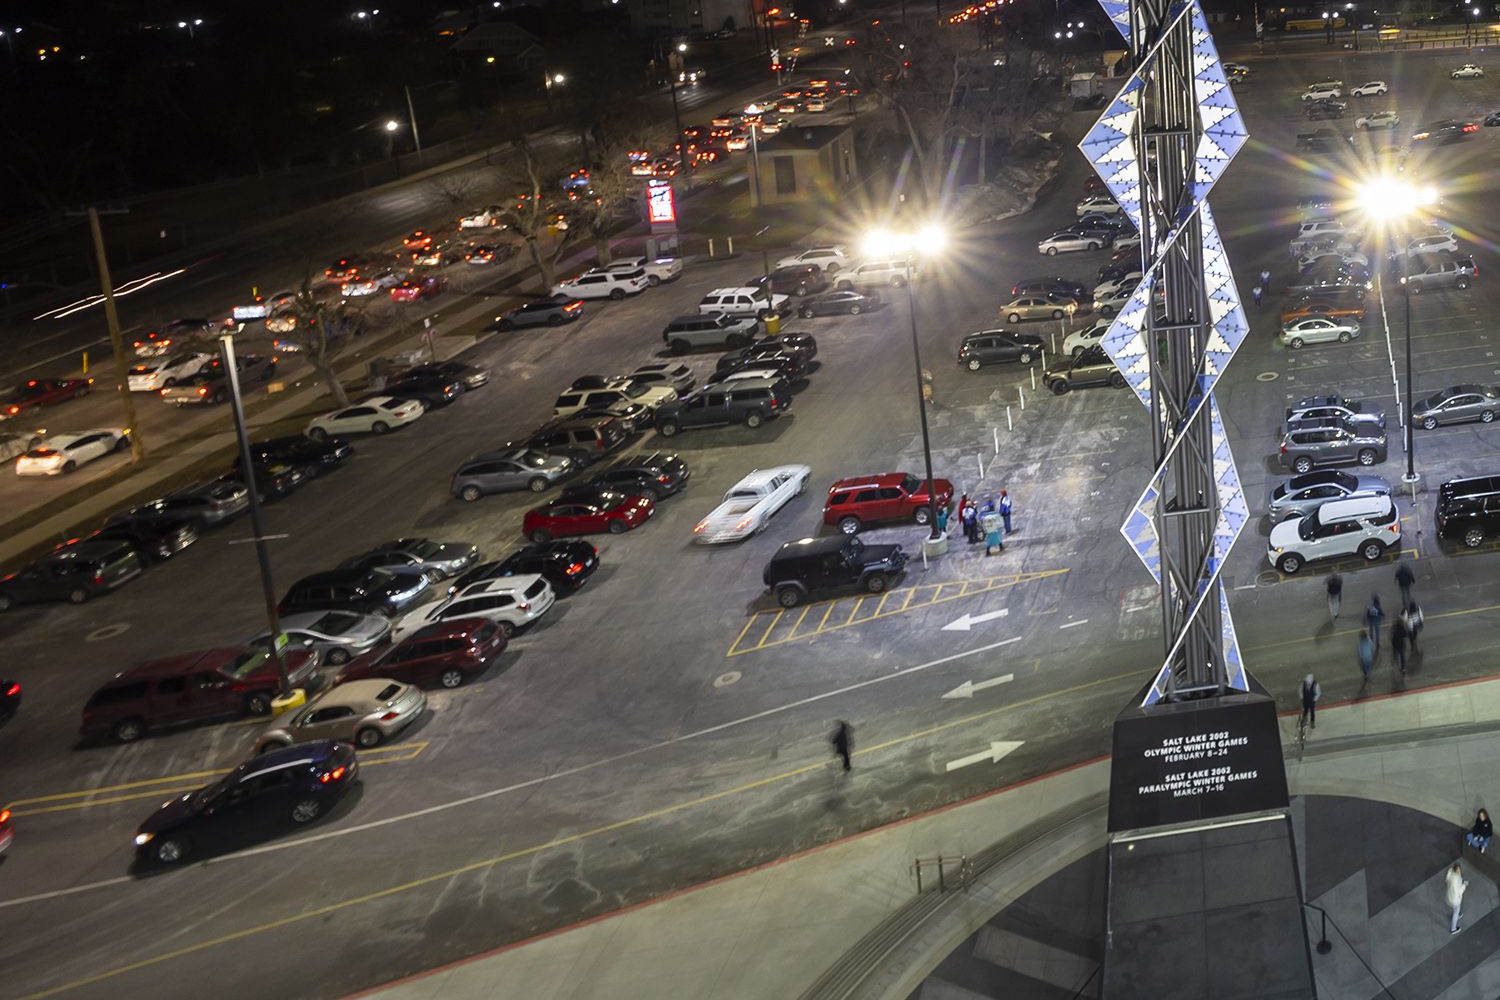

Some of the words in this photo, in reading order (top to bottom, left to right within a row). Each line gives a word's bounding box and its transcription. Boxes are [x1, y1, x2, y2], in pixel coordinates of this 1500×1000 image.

[1144, 745, 1182, 758] OLYMPIC
[1183, 741, 1216, 753] WINTER
[1218, 736, 1248, 748] GAMES
[1162, 737, 1184, 747] SALT
[1185, 733, 1207, 744] LAKE
[1209, 731, 1230, 741] 2002
[1164, 751, 1205, 763] FEBRUARY
[1138, 780, 1192, 795] PARALYMPIC
[1193, 775, 1226, 787] WINTER
[1227, 770, 1258, 782] GAMES
[1165, 772, 1186, 783] SALT
[1187, 769, 1209, 780] LAKE
[1211, 766, 1231, 776] 2002
[1173, 786, 1203, 798] MARCH
